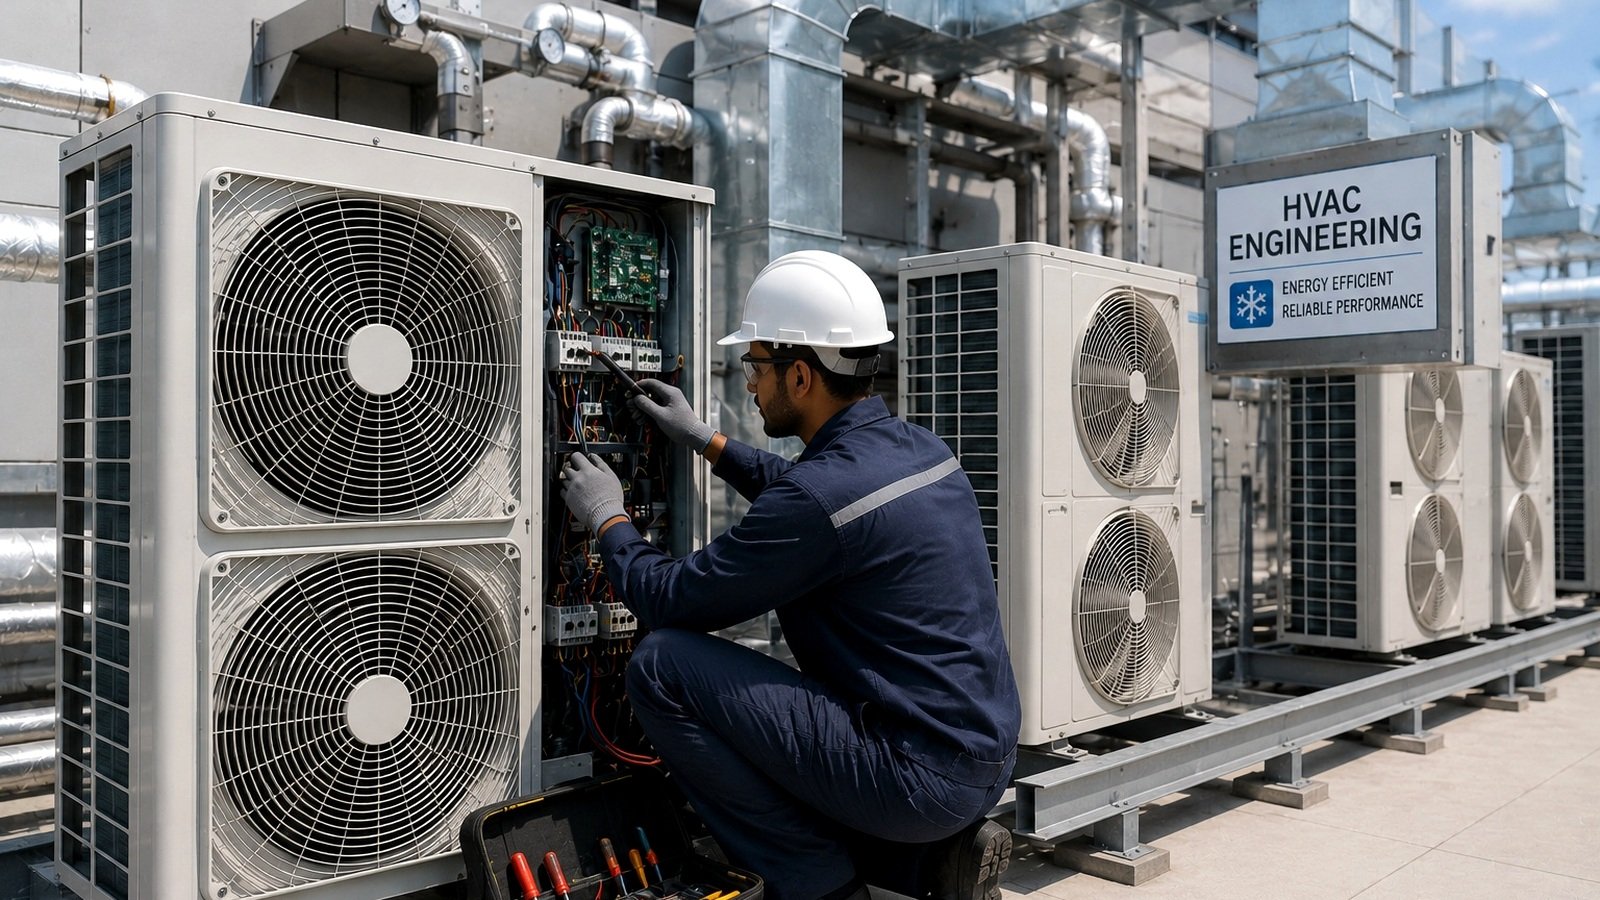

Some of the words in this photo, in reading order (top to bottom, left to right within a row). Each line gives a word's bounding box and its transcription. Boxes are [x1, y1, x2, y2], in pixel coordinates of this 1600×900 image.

[1283, 185, 1361, 221] HVAC
[1229, 212, 1421, 261] ENGINEERING
[1282, 277, 1328, 295] ENERGY
[1332, 270, 1394, 291] EFFICIENT
[1282, 299, 1333, 318] RELIABLE
[1336, 293, 1424, 314] PERFORMANCE
